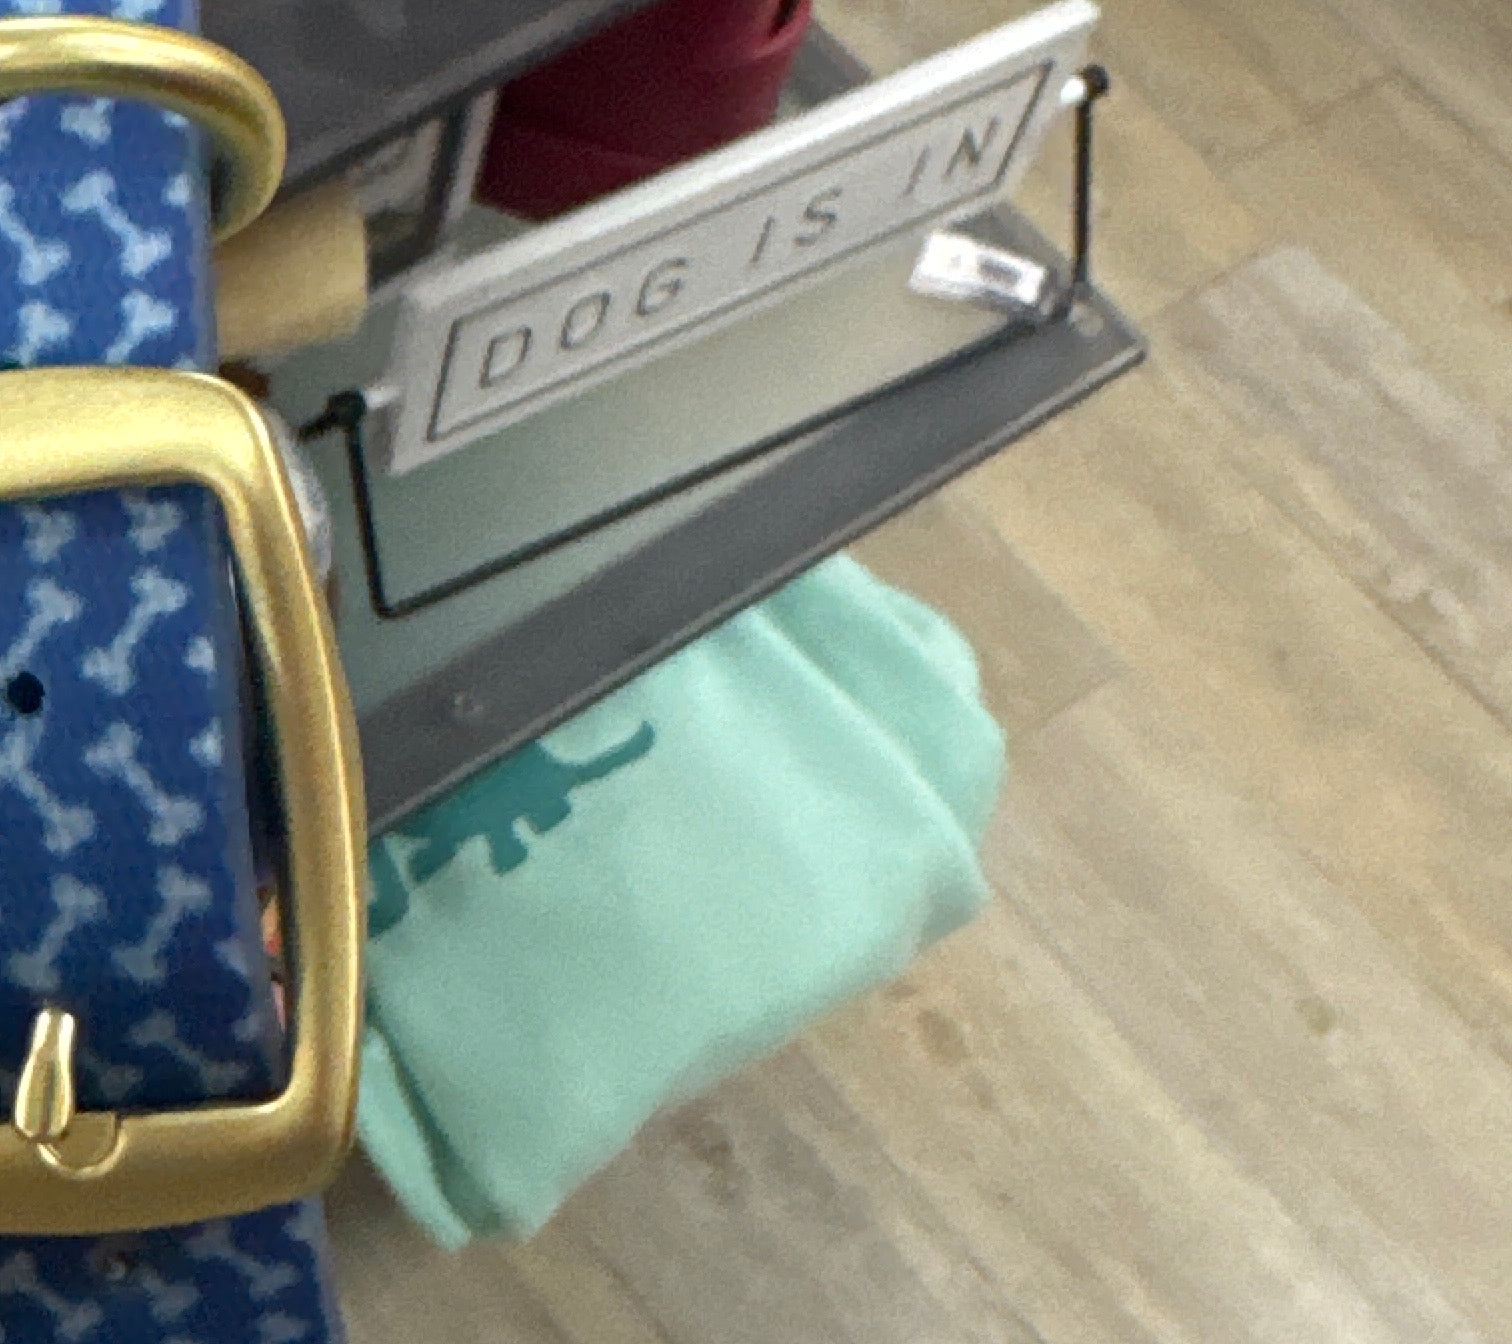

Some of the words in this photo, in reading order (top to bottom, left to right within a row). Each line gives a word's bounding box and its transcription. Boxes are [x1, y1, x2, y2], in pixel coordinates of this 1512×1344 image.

[478, 256, 688, 391] DOG
[749, 187, 843, 268] IS
[899, 117, 1004, 198] IN
